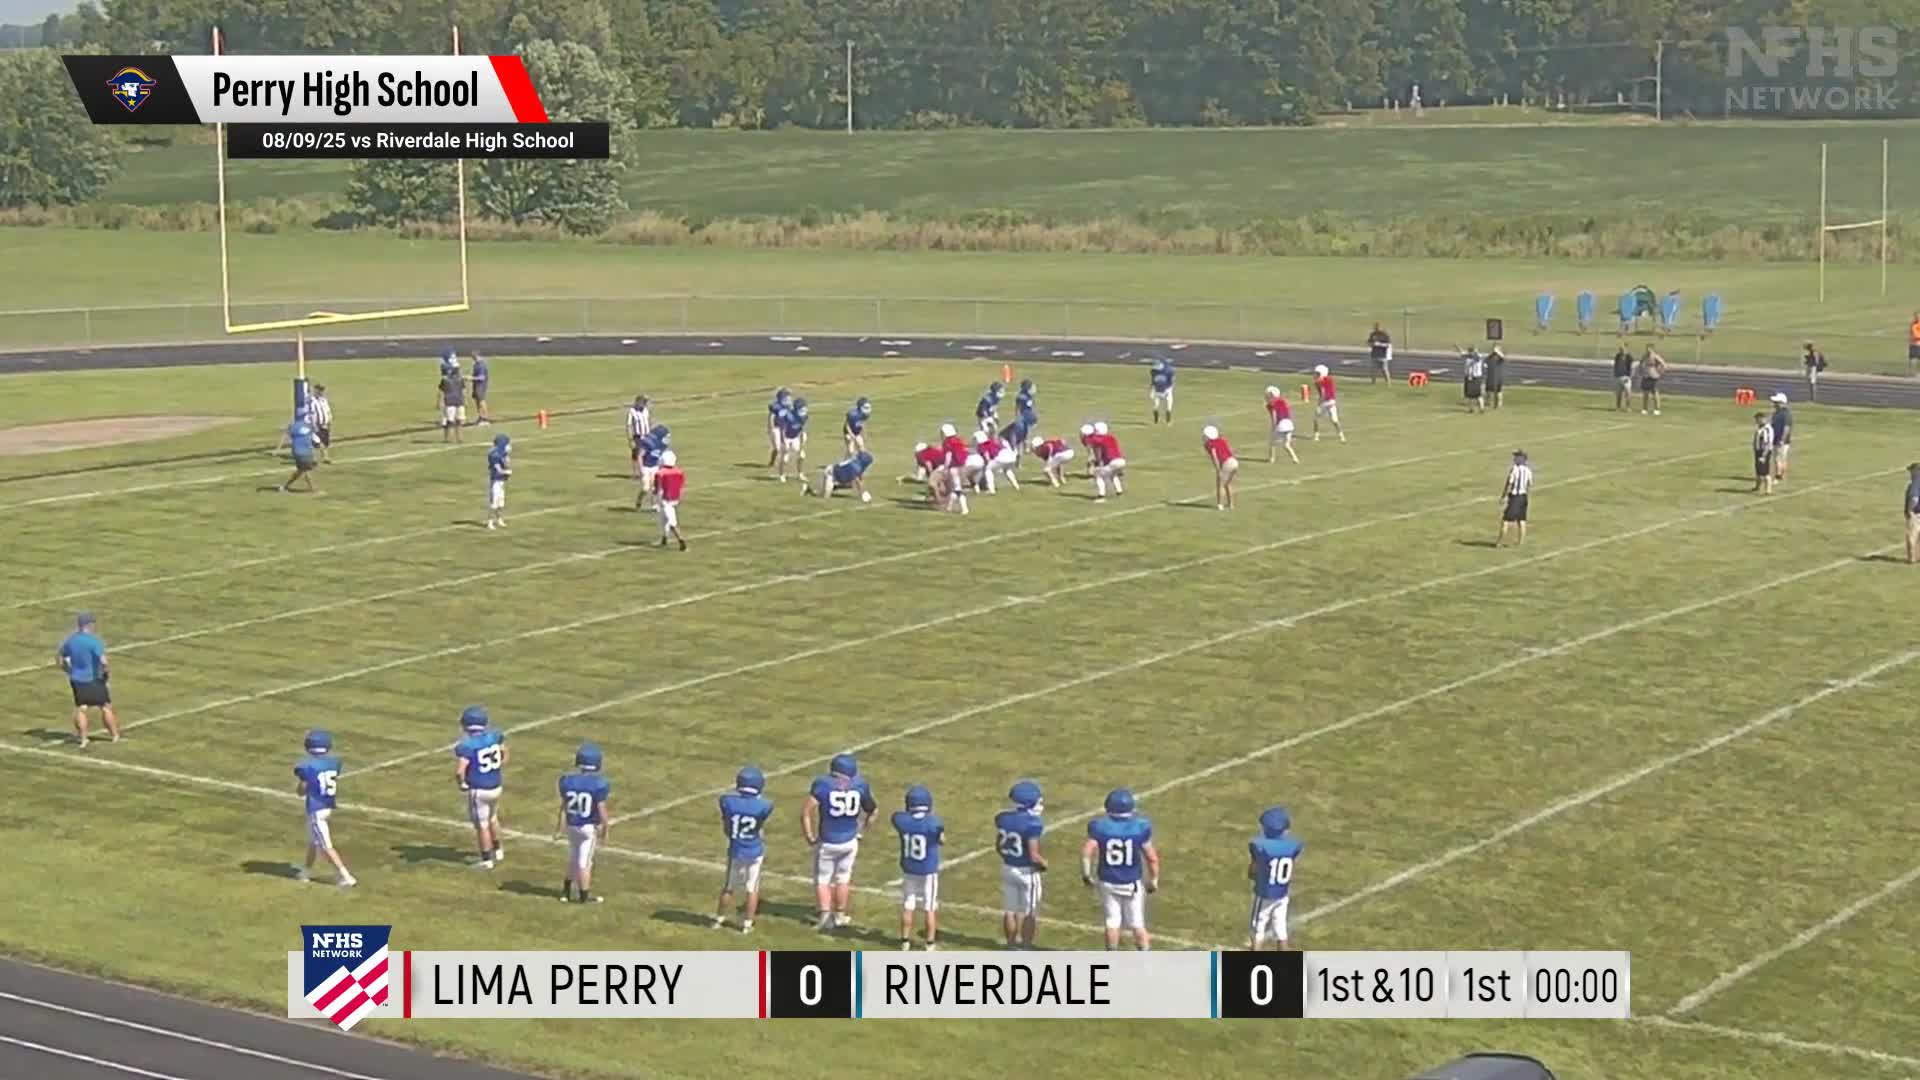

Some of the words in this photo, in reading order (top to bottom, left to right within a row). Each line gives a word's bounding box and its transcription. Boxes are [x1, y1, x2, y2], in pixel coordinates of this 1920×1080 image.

[478, 743, 501, 773] 53
[318, 771, 336, 796] 15
[567, 791, 592, 818] 20
[829, 790, 861, 816] 50
[730, 814, 756, 839] 12
[903, 833, 927, 861] 18
[998, 829, 1023, 857] 23
[1106, 838, 1134, 866] 61
[1268, 857, 1294, 885] 10
